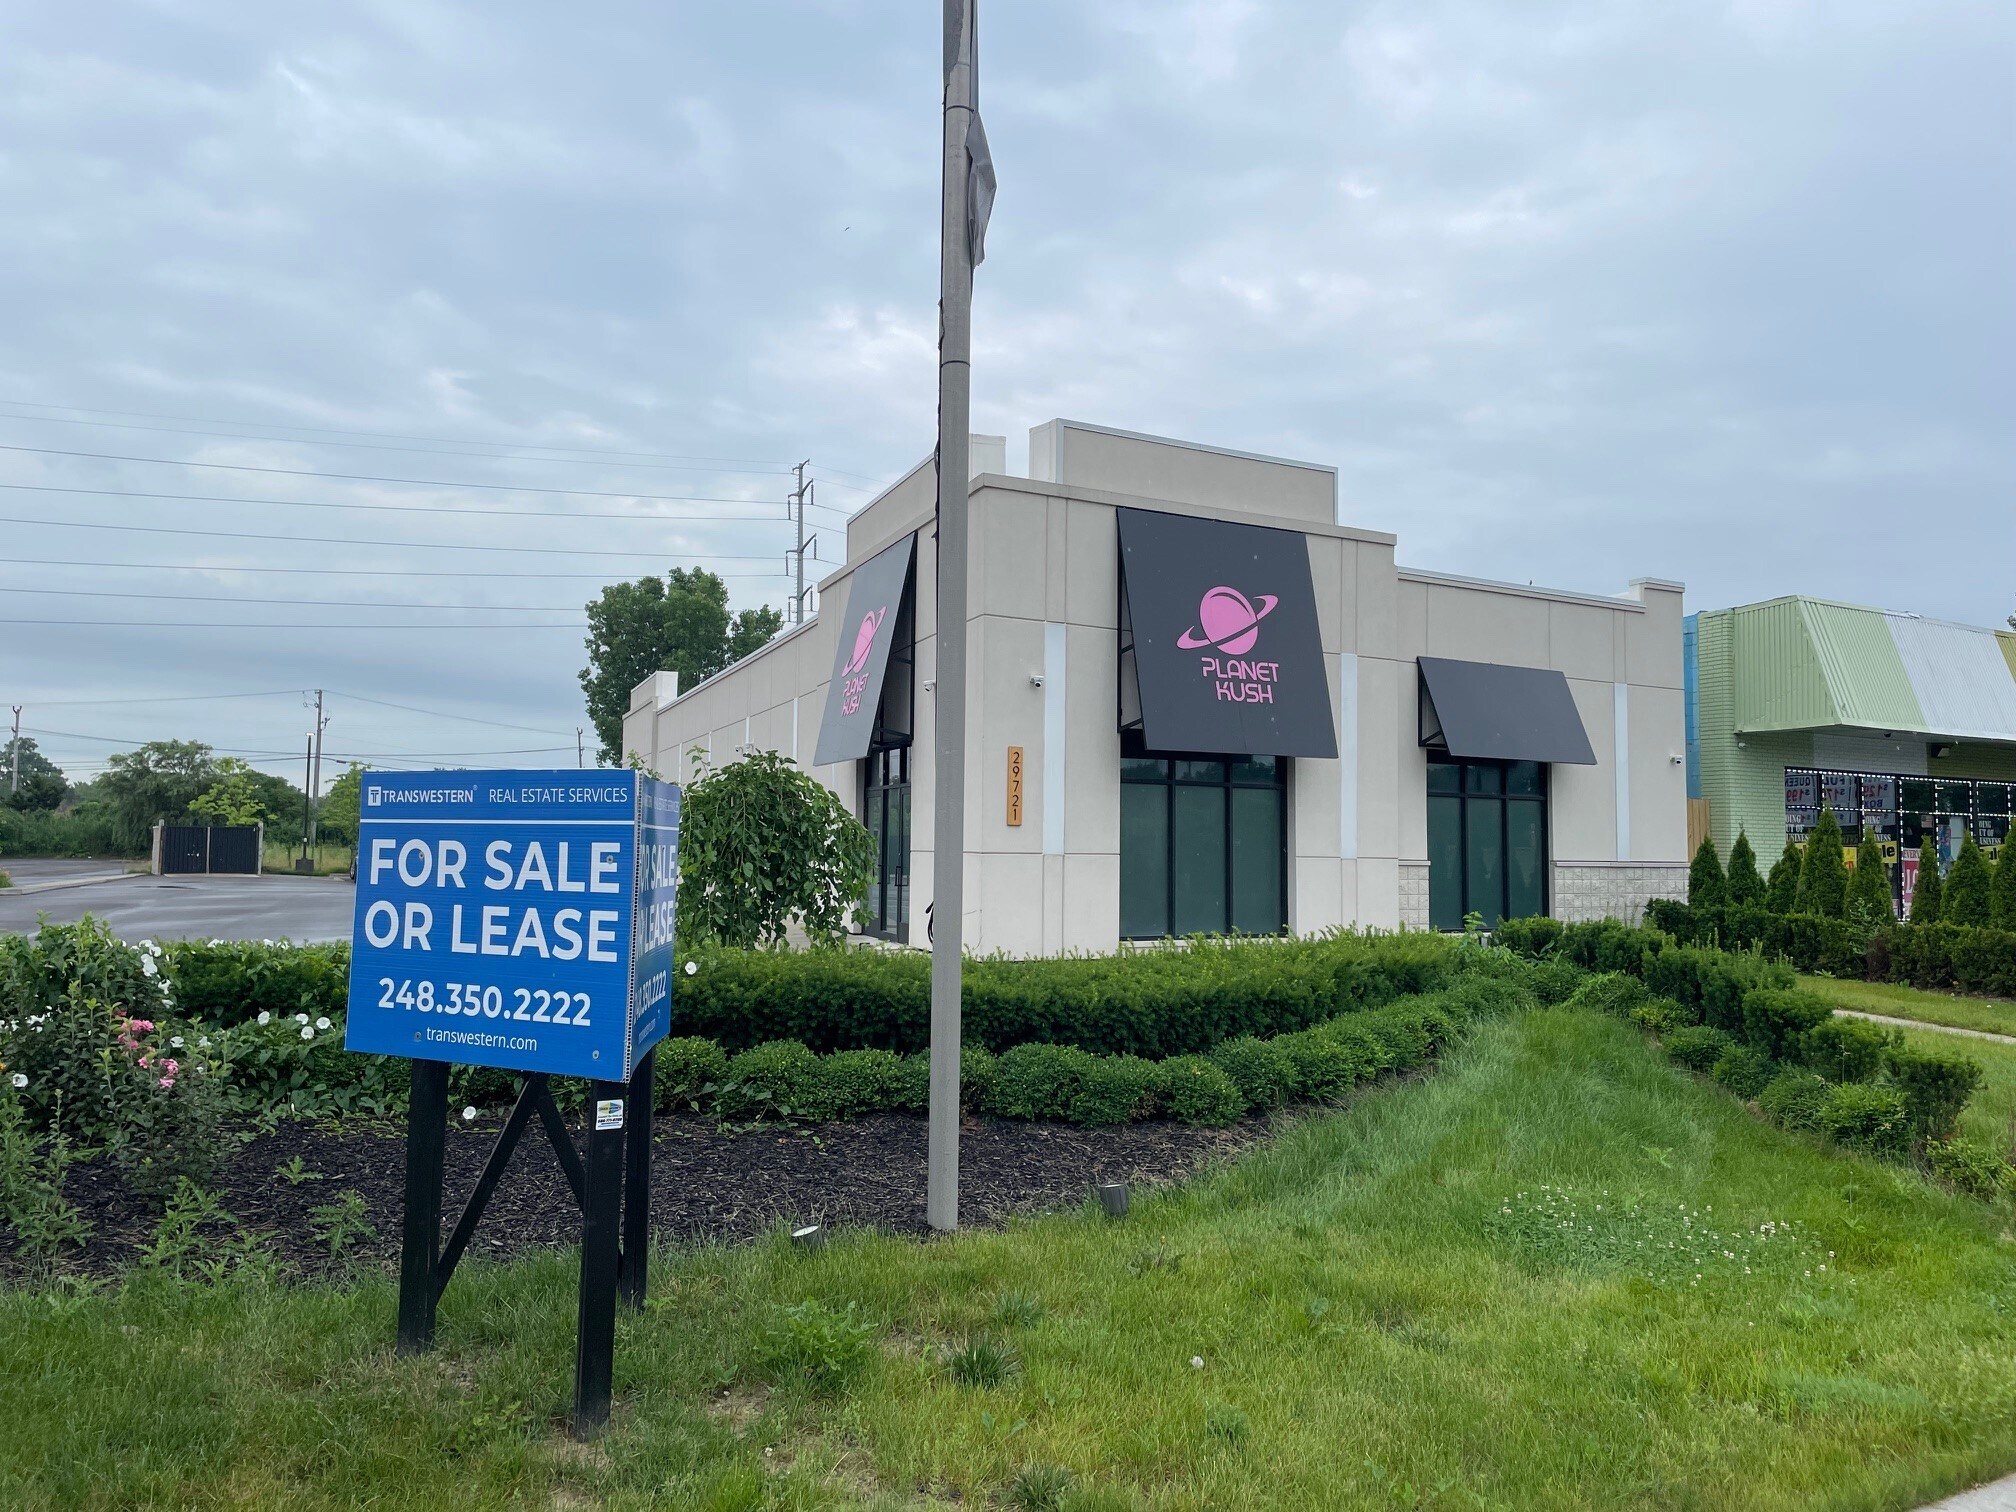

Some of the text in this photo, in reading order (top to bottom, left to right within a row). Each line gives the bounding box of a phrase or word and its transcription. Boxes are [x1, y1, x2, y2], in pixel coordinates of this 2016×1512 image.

[1201, 657, 1280, 683] PLANET
[1215, 681, 1274, 704] KUSH
[382, 789, 474, 803] TRANSWESTERN
[488, 788, 518, 803] REAL
[521, 788, 565, 803] ESTATE
[568, 787, 628, 803] SERVICES
[1011, 751, 1020, 821] 29721
[1786, 814, 1801, 823] OING
[369, 838, 621, 894] FOR SALE
[651, 844, 677, 890] SALE
[1881, 844, 1895, 858] le
[364, 900, 619, 963] OR LEASE
[644, 900, 674, 954] LEASE
[378, 977, 591, 1027] 248.350.2222
[426, 1027, 538, 1052] transwestern.com
